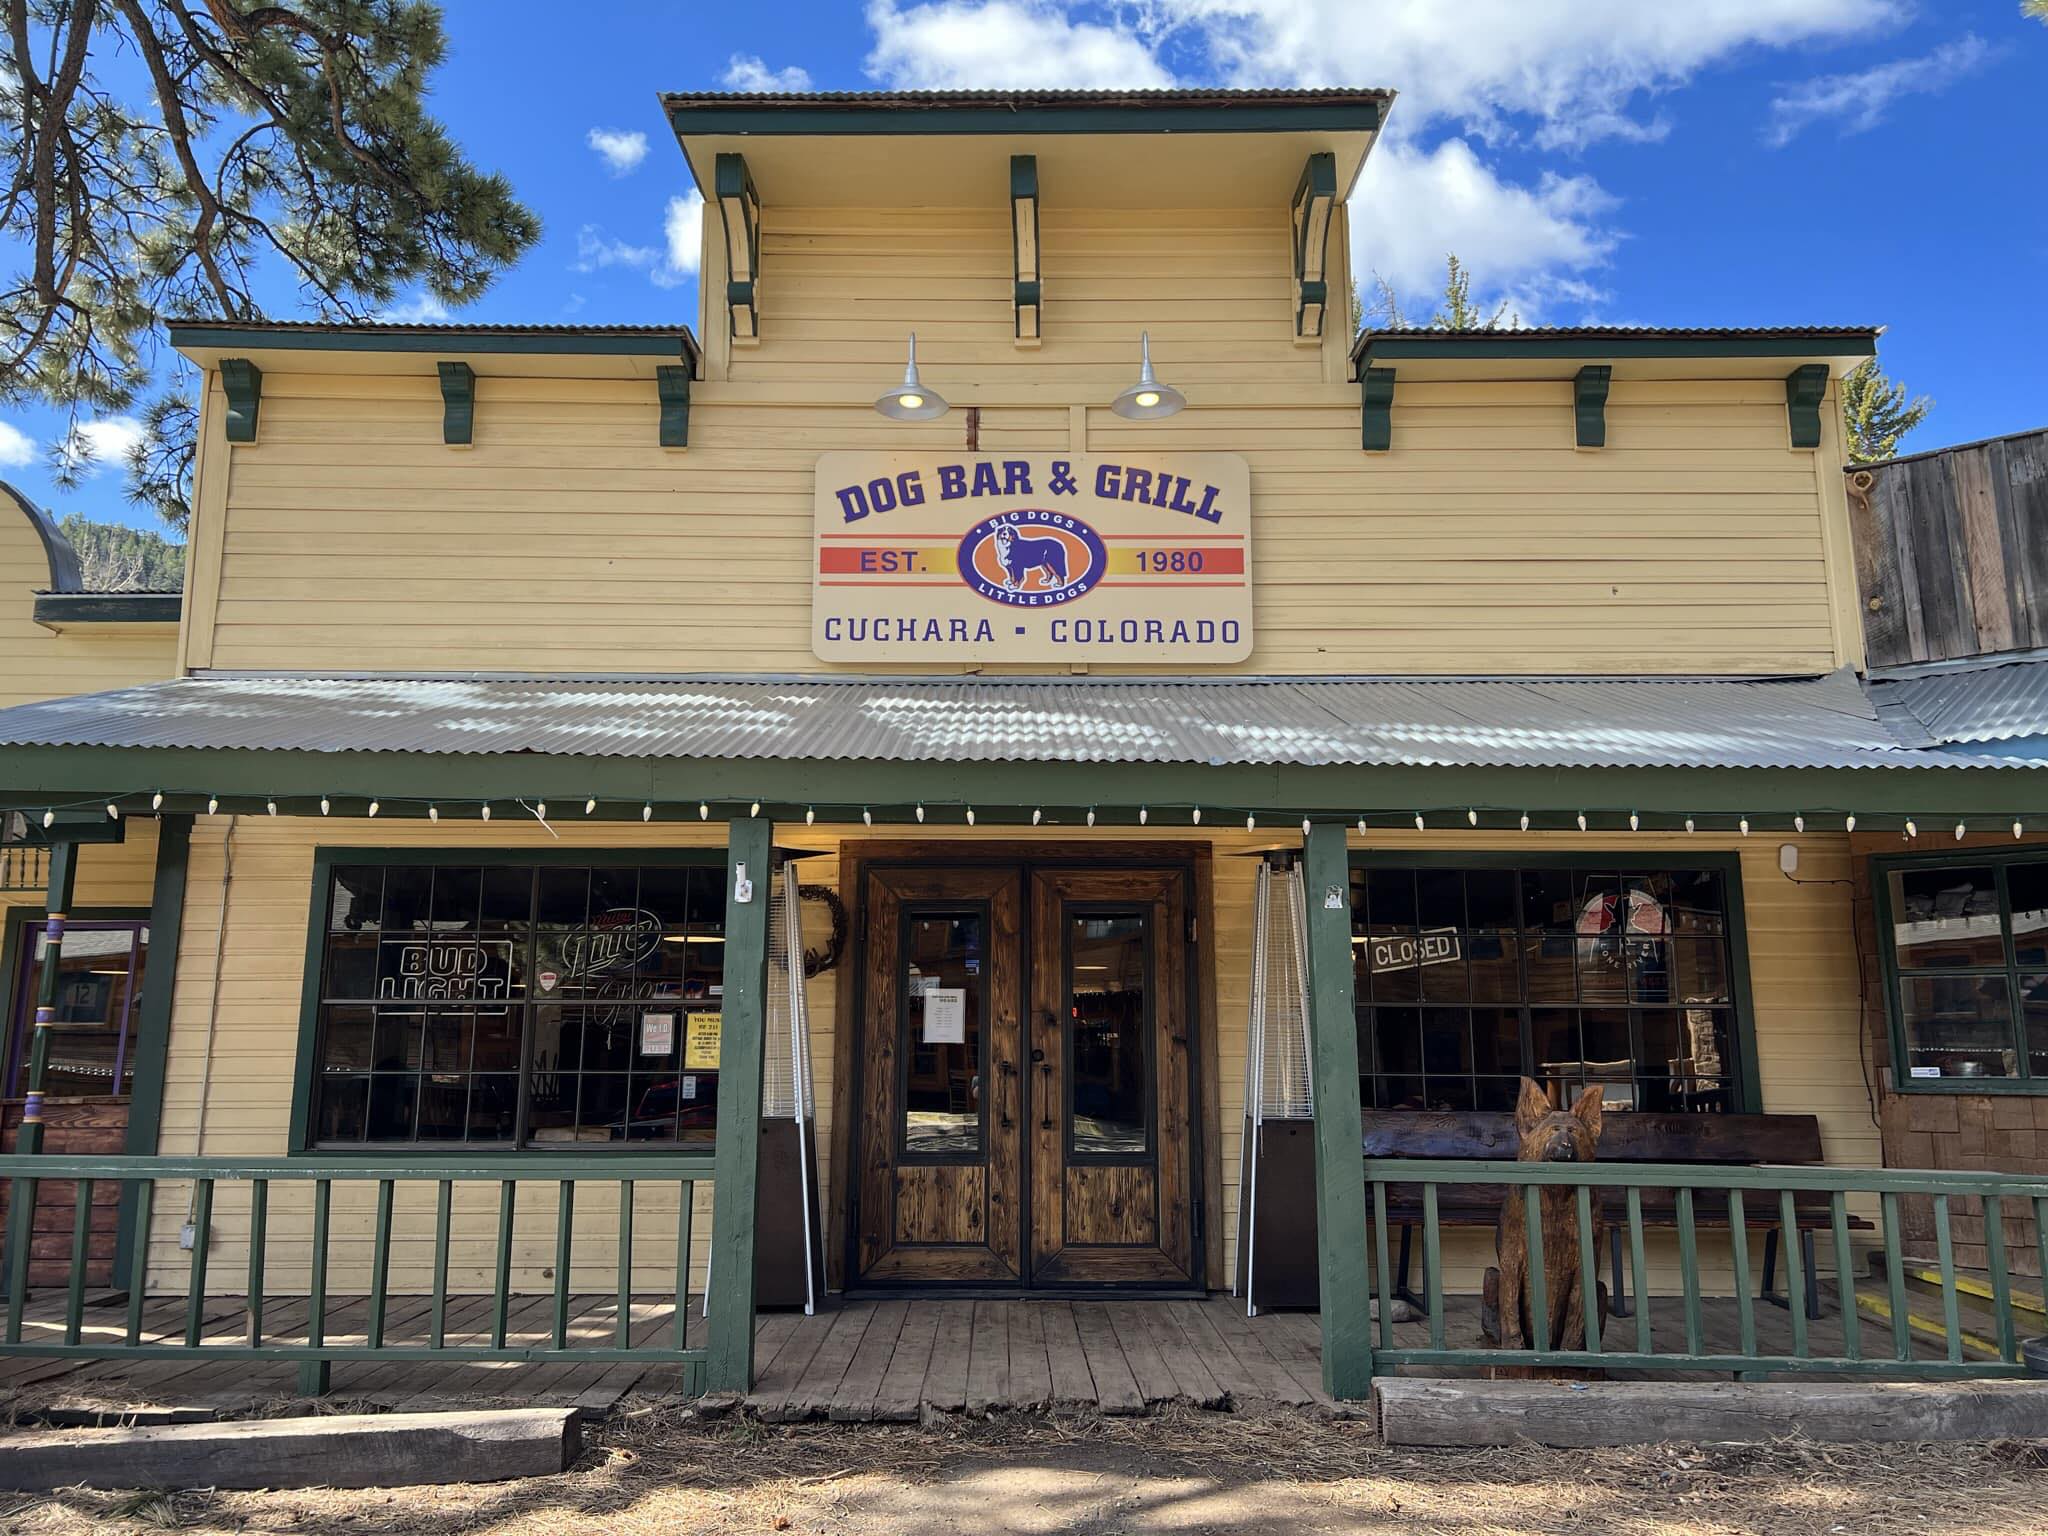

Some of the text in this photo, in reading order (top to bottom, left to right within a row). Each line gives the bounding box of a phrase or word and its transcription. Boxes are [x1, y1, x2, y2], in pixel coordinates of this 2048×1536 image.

[836, 461, 1222, 524] DOG BAR & GRILL
[989, 511, 1075, 529] BIG DOGS
[861, 551, 927, 572] EST.
[1136, 551, 1204, 572] 1980
[978, 582, 1088, 604] LITTLE DOGS
[825, 618, 1239, 643] CUCHARA COLORADO
[400, 946, 488, 976] BUD
[1375, 936, 1450, 966] CLOSED
[381, 977, 504, 1007] LIGHT
